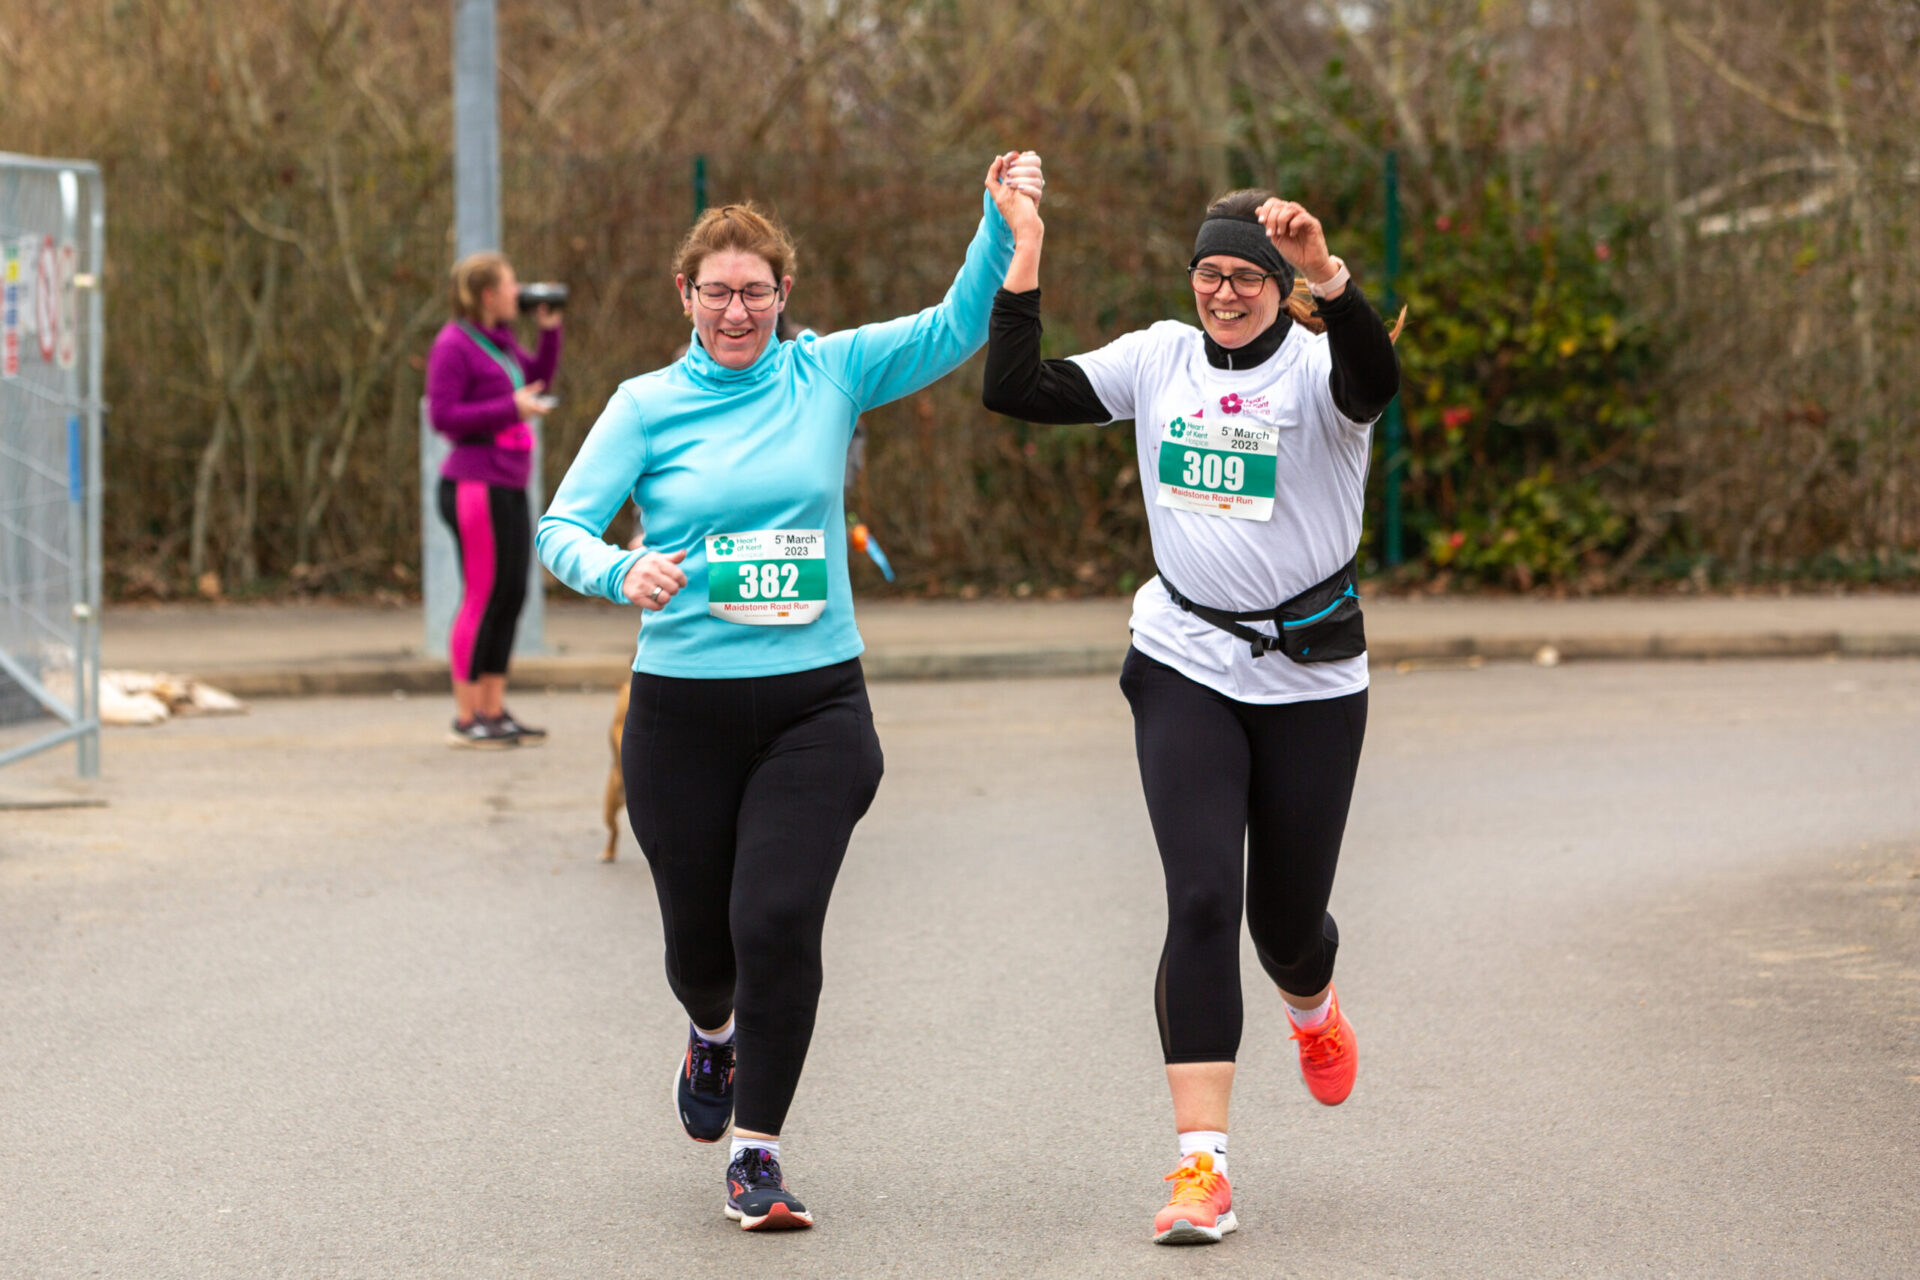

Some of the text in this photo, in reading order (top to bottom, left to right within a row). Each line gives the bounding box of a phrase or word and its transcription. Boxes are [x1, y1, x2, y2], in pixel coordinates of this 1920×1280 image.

[1187, 422, 1205, 430] Heart
[1193, 431, 1208, 439] Kent
[1234, 428, 1270, 440] March
[1185, 437, 1209, 447] Hospice
[1231, 439, 1259, 451] 2023
[1182, 450, 1245, 492] 309
[1171, 487, 1253, 505] Maidstone Road Run
[786, 535, 817, 544] March
[784, 547, 809, 556] 2023
[738, 563, 799, 599] 382
[724, 603, 768, 611] Maidstone
